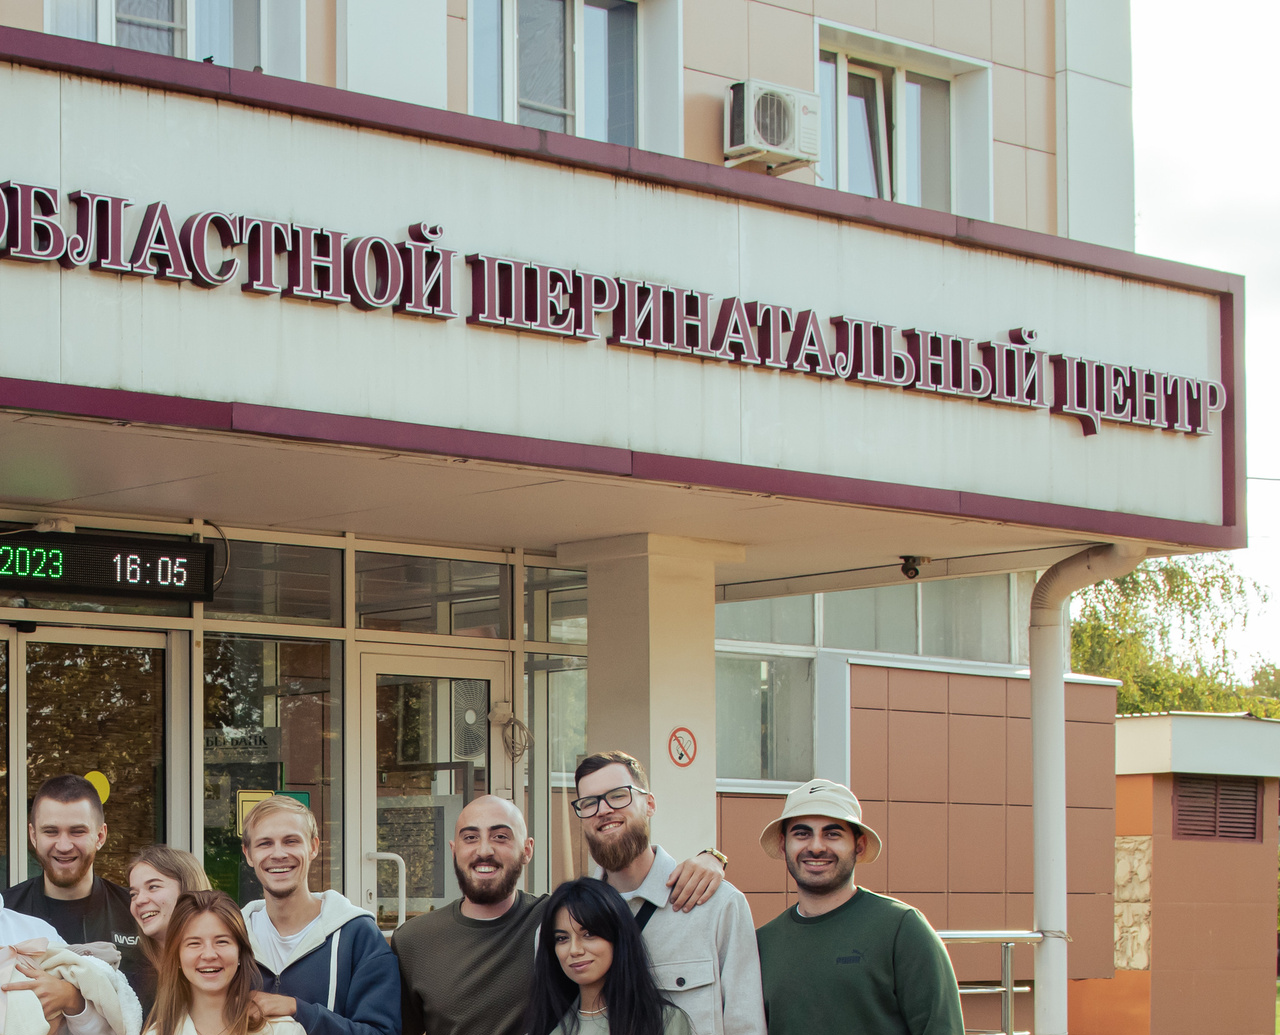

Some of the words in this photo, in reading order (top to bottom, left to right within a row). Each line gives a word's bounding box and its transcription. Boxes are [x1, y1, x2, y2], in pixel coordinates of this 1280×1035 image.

[465, 252, 1050, 411] ПЕРИНАТАЛЬНЫЙ
[1048, 352, 1226, 437] ЦЕНТР
[113, 553, 187, 587] 16:05
